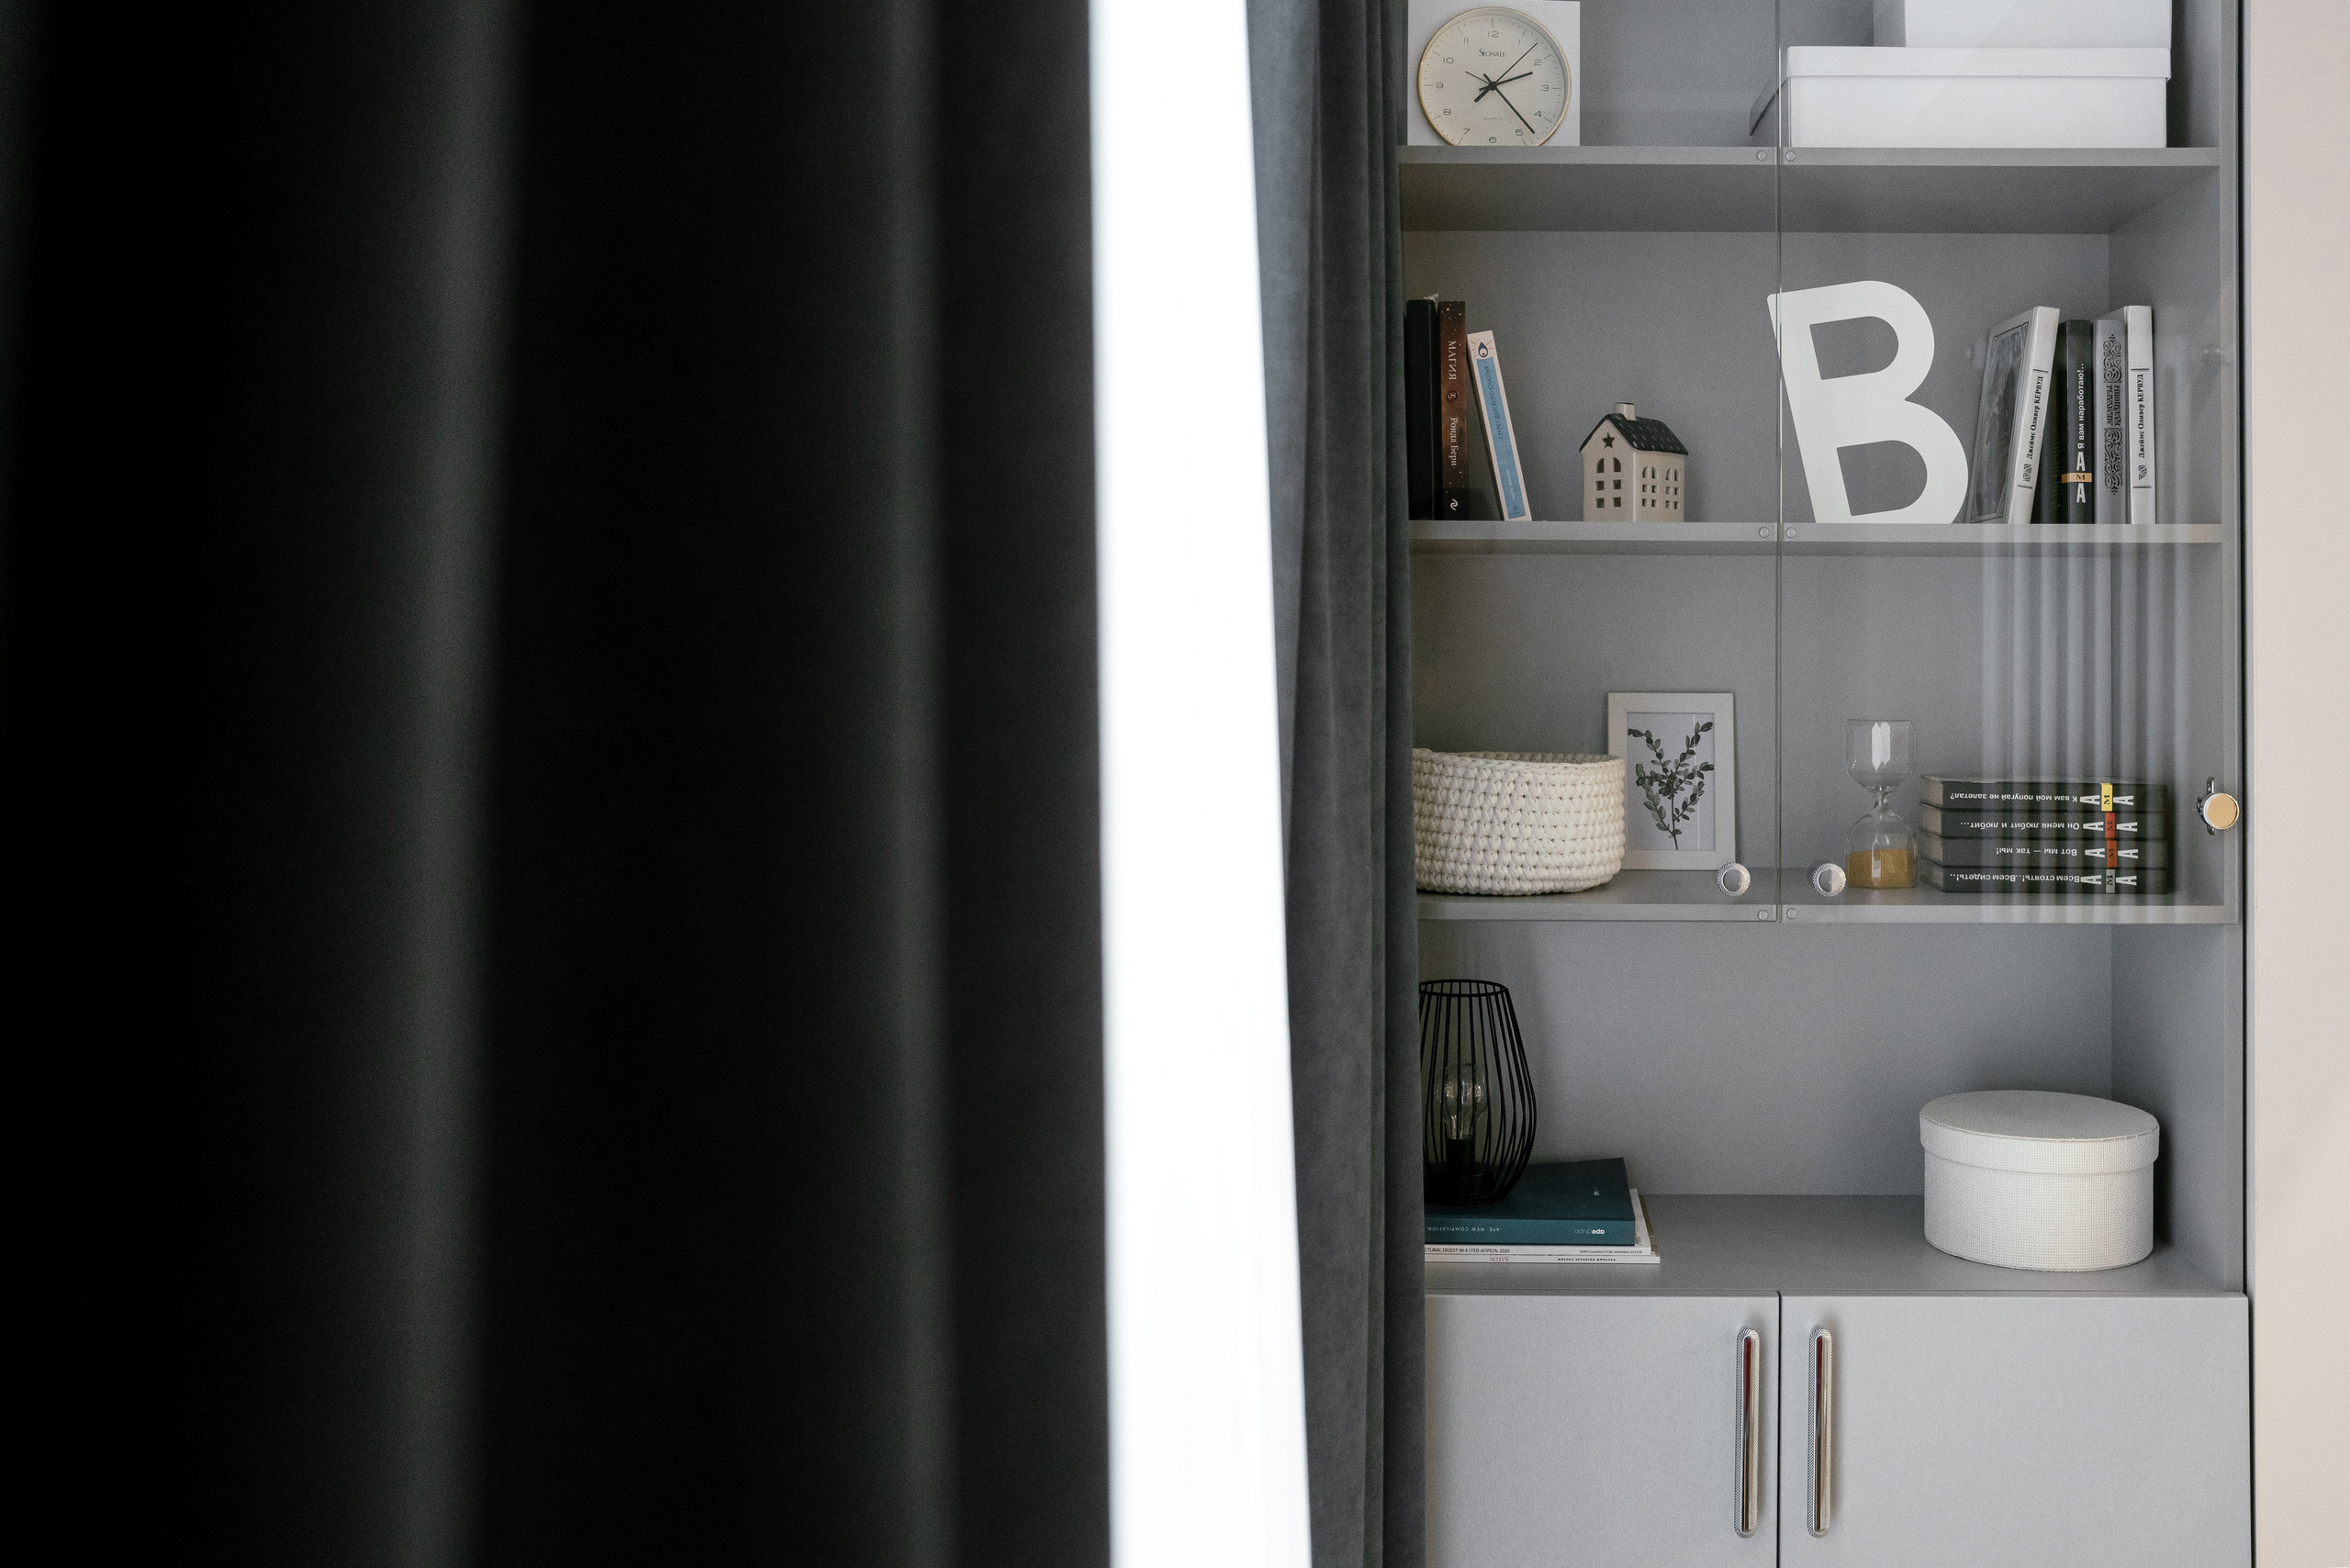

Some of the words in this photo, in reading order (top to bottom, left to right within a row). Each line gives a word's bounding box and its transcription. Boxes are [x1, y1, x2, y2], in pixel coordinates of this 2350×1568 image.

[1488, 136, 1497, 144] 6
[1448, 341, 1457, 380] МАГИЯ
[2033, 375, 2044, 405] КЕРВУД
[2076, 363, 2086, 421] наработаю!..
[2136, 374, 2144, 403] КЕРВУД
[2031, 406, 2041, 431] Оливер
[2137, 404, 2145, 430] Оливер
[1450, 418, 1459, 442] Ронда
[1494, 420, 1504, 440] СЕКРЕТ
[1448, 445, 1459, 466] Берн
[2026, 432, 2037, 461] Джеймс
[1960, 822, 1999, 830] любит...
[2010, 822, 2039, 830] любит
[2061, 848, 2077, 857] Вот
[1950, 873, 1991, 881] сидеть!..
[2056, 875, 2080, 883] Всем
